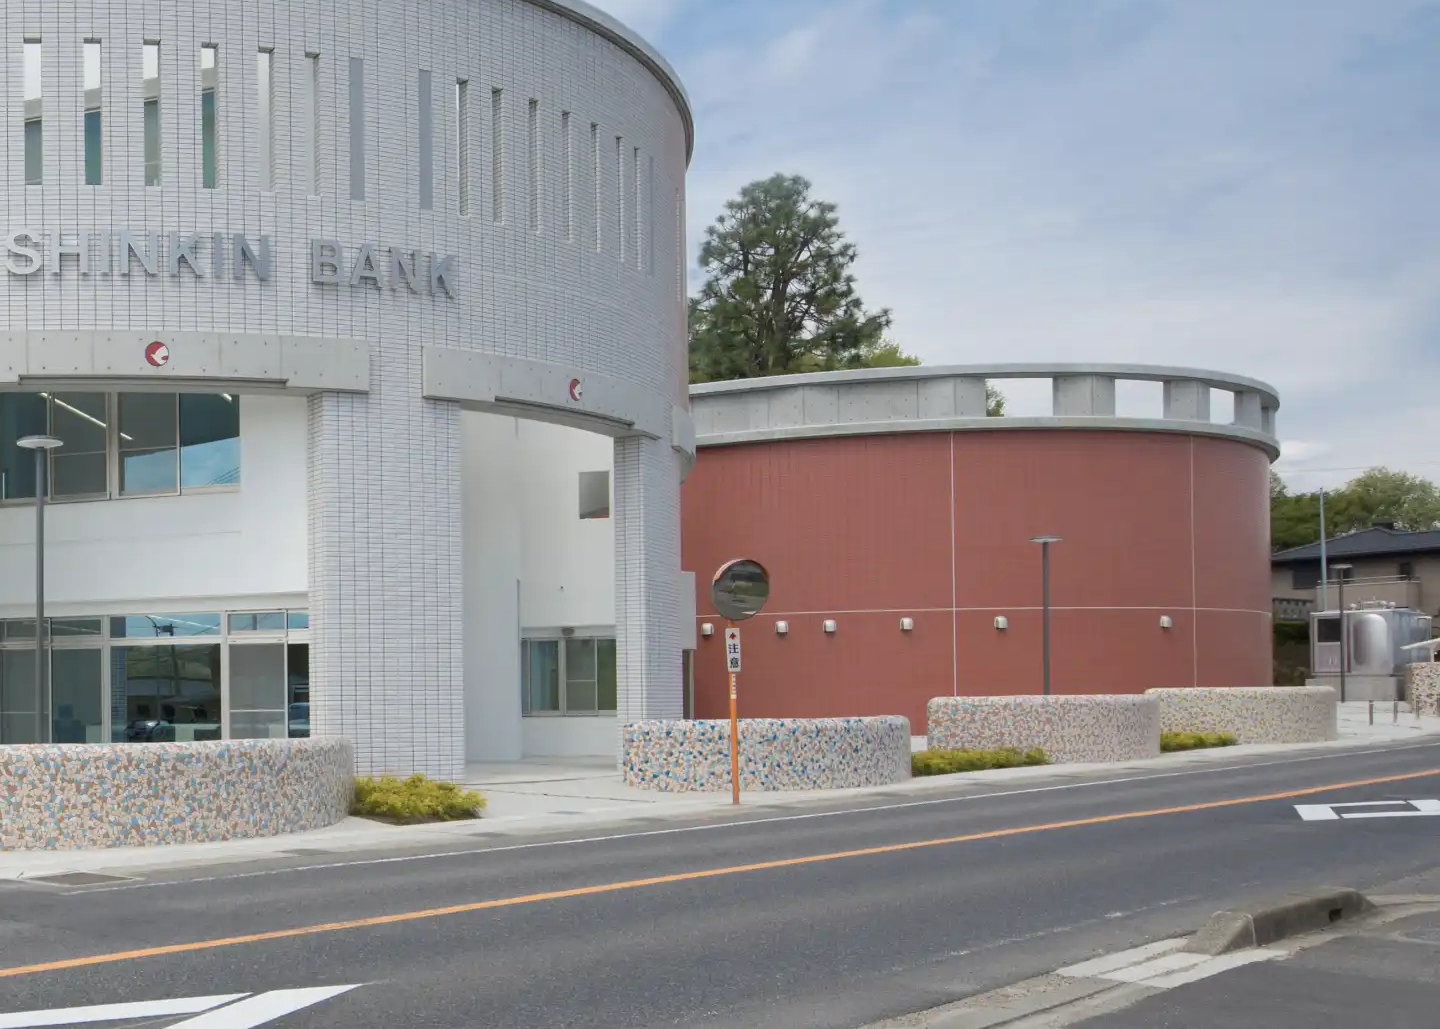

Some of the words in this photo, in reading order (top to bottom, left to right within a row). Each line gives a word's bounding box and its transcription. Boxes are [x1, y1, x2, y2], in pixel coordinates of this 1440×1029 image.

[4, 227, 270, 281] SHINKIN
[312, 238, 458, 300] BANK
[728, 643, 740, 669] 注意
